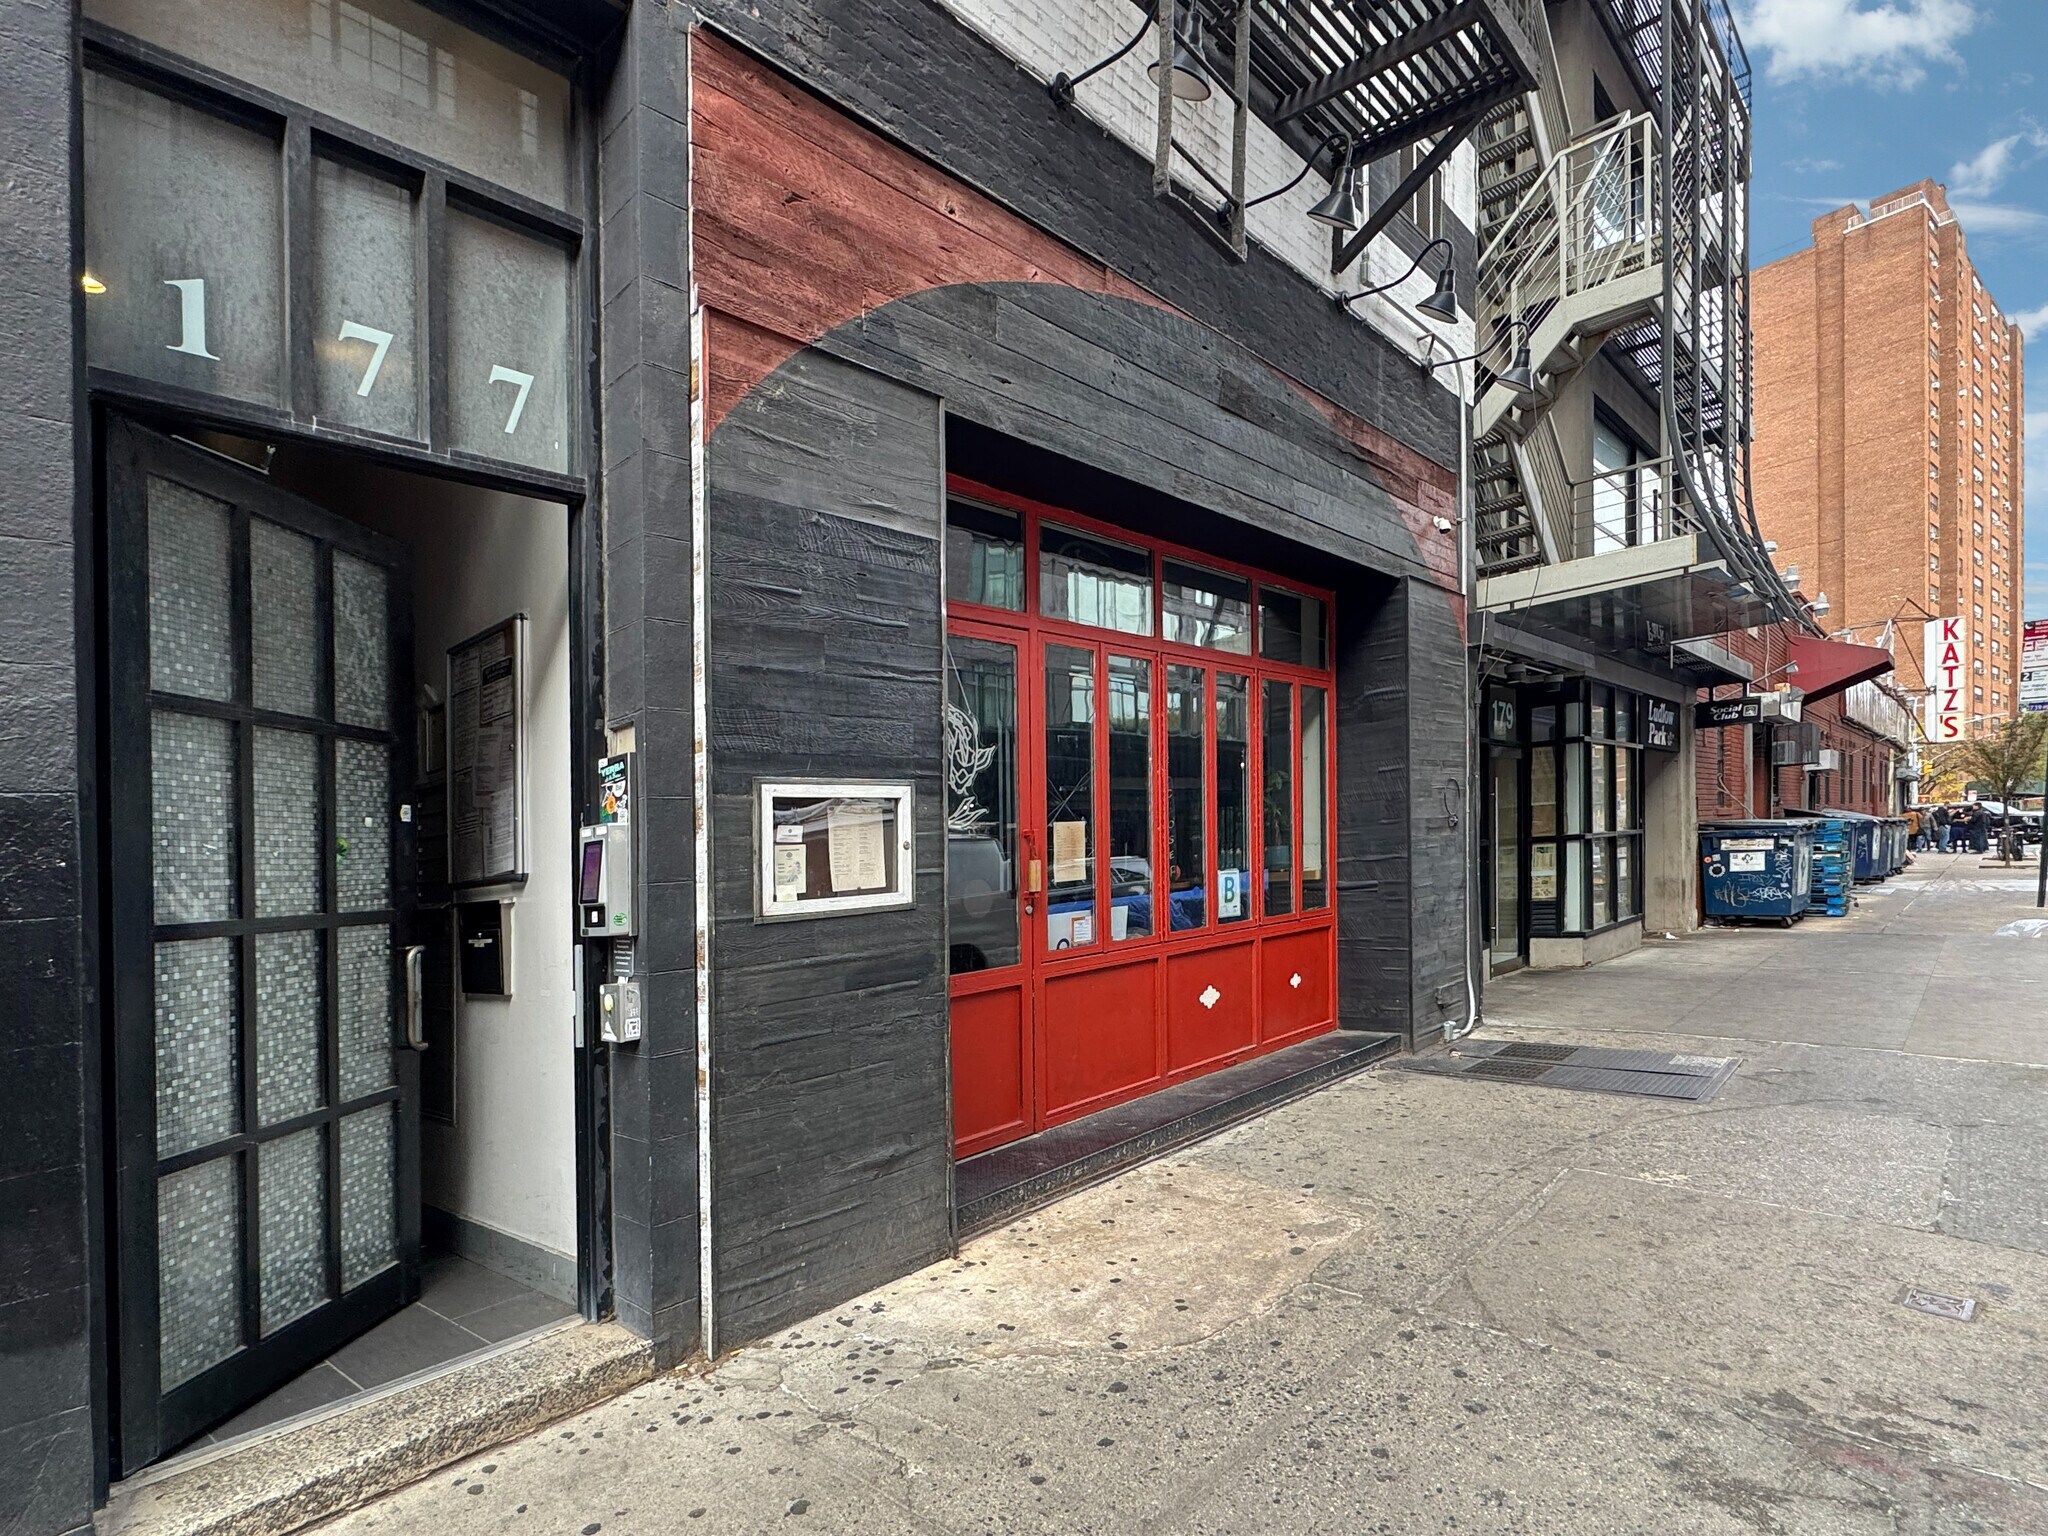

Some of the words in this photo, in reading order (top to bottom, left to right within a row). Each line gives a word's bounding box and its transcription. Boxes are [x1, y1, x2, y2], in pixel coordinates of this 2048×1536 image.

[1940, 618, 1960, 738] KATZ'S
[2023, 672, 2030, 681] 2
[1492, 699, 1514, 730] 179
[1648, 699, 1675, 726] Ludlow
[1710, 703, 1743, 715] Social
[1713, 712, 1739, 721] Club
[1648, 722, 1667, 746] Park
[600, 761, 625, 777] YERBA
[1224, 876, 1235, 903] B
